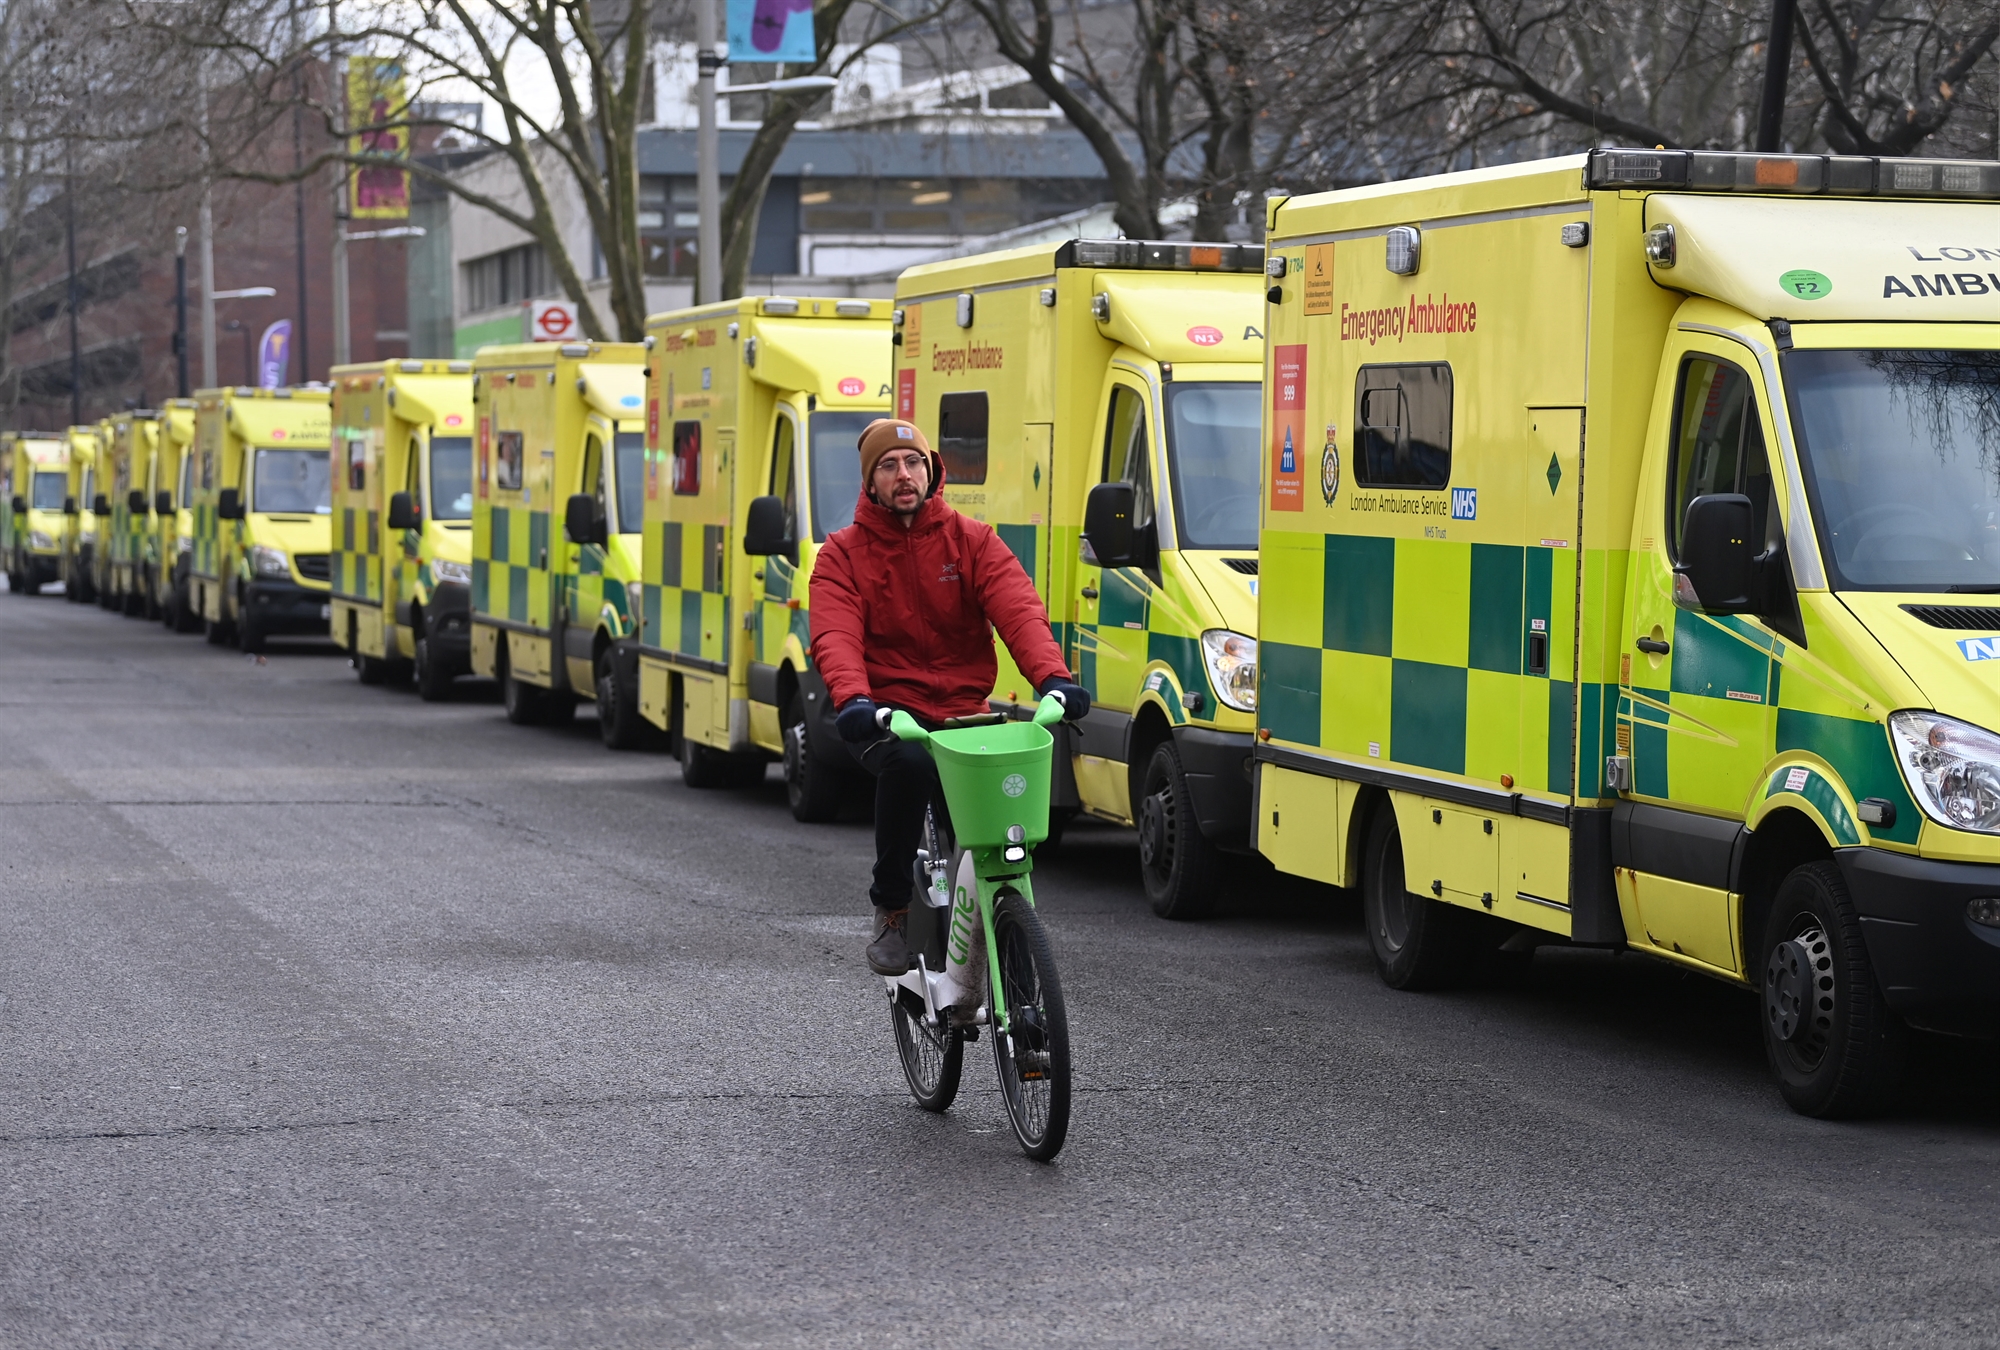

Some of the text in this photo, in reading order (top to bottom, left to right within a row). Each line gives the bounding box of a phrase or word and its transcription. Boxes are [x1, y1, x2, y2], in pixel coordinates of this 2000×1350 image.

[1795, 282, 1821, 294] F2
[1341, 292, 1477, 346] Emergency Ambulance
[1194, 333, 1217, 344] N1
[933, 339, 1003, 376] Emergency Ambulance
[1284, 384, 1295, 401] 999
[1283, 451, 1293, 468] 111
[1350, 488, 1477, 519] London Ambulance Service NHS
[1435, 527, 1447, 539] Trust
[947, 885, 975, 965] Lime
